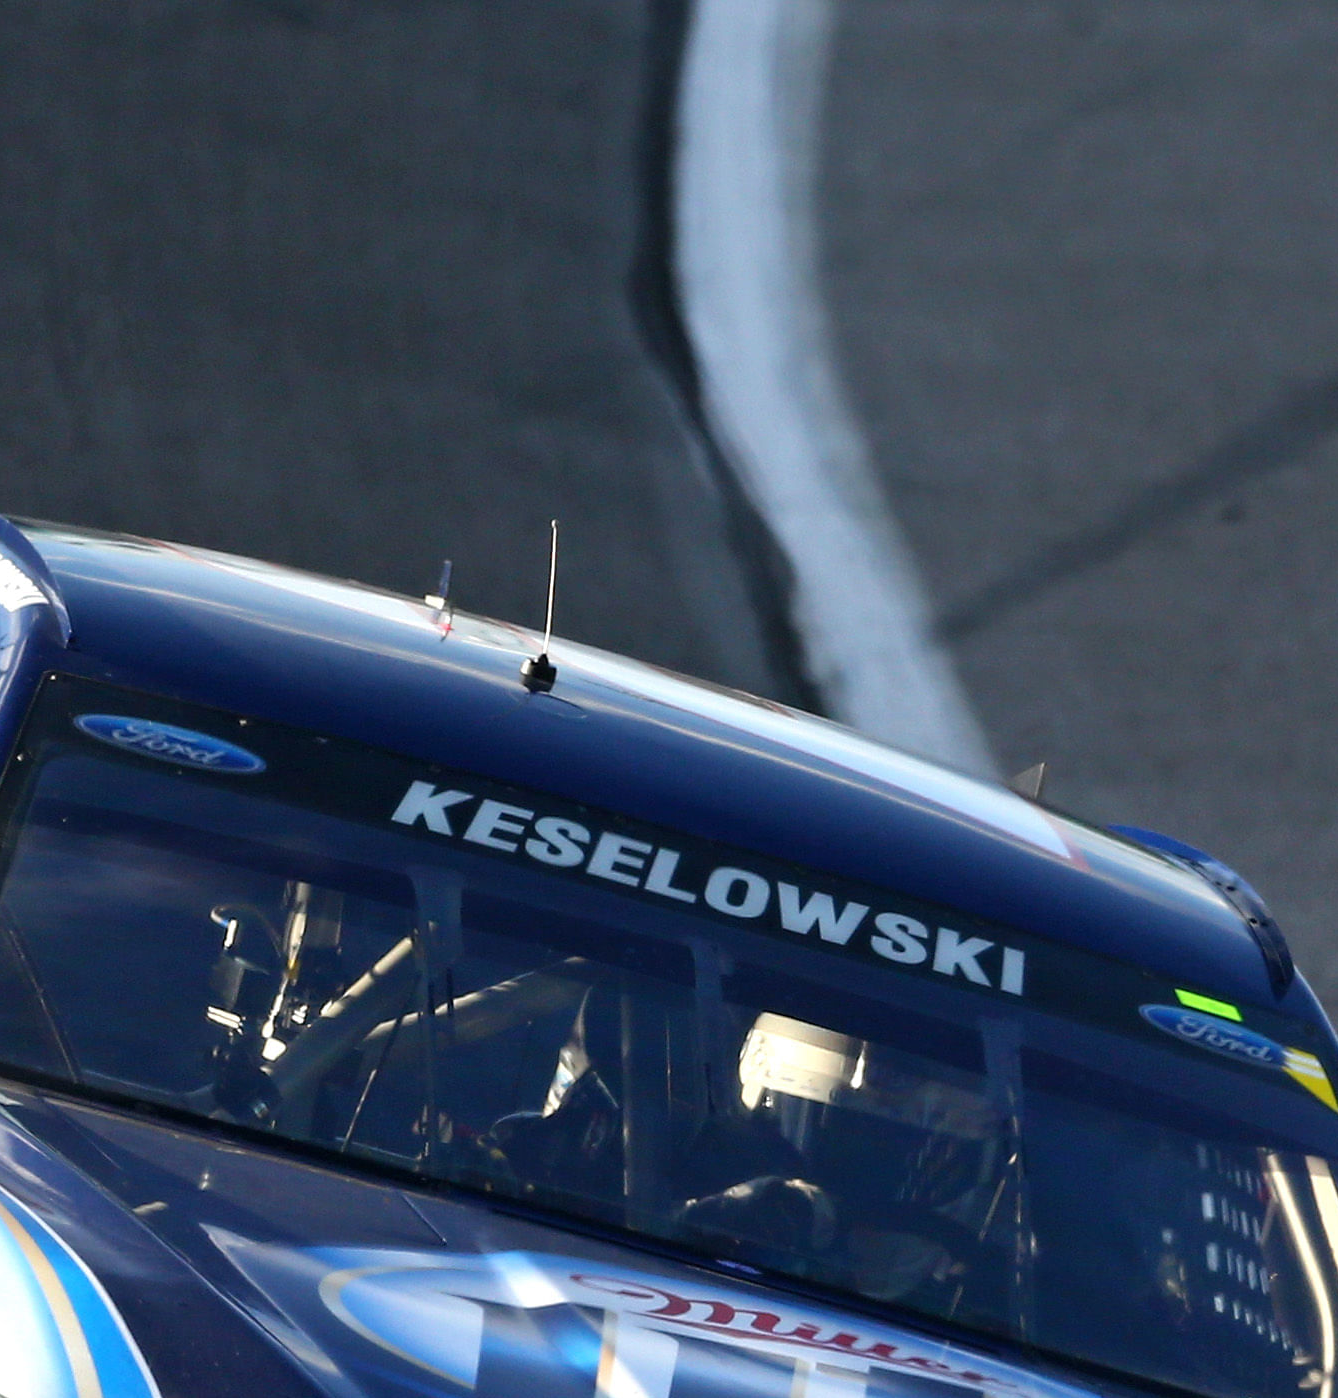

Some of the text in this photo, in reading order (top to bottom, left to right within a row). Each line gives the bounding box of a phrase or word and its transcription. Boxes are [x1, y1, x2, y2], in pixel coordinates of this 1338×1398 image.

[112, 725, 226, 765] Ford
[390, 779, 1026, 996] KESELOWSKI
[1175, 1015, 1274, 1063] Ford
